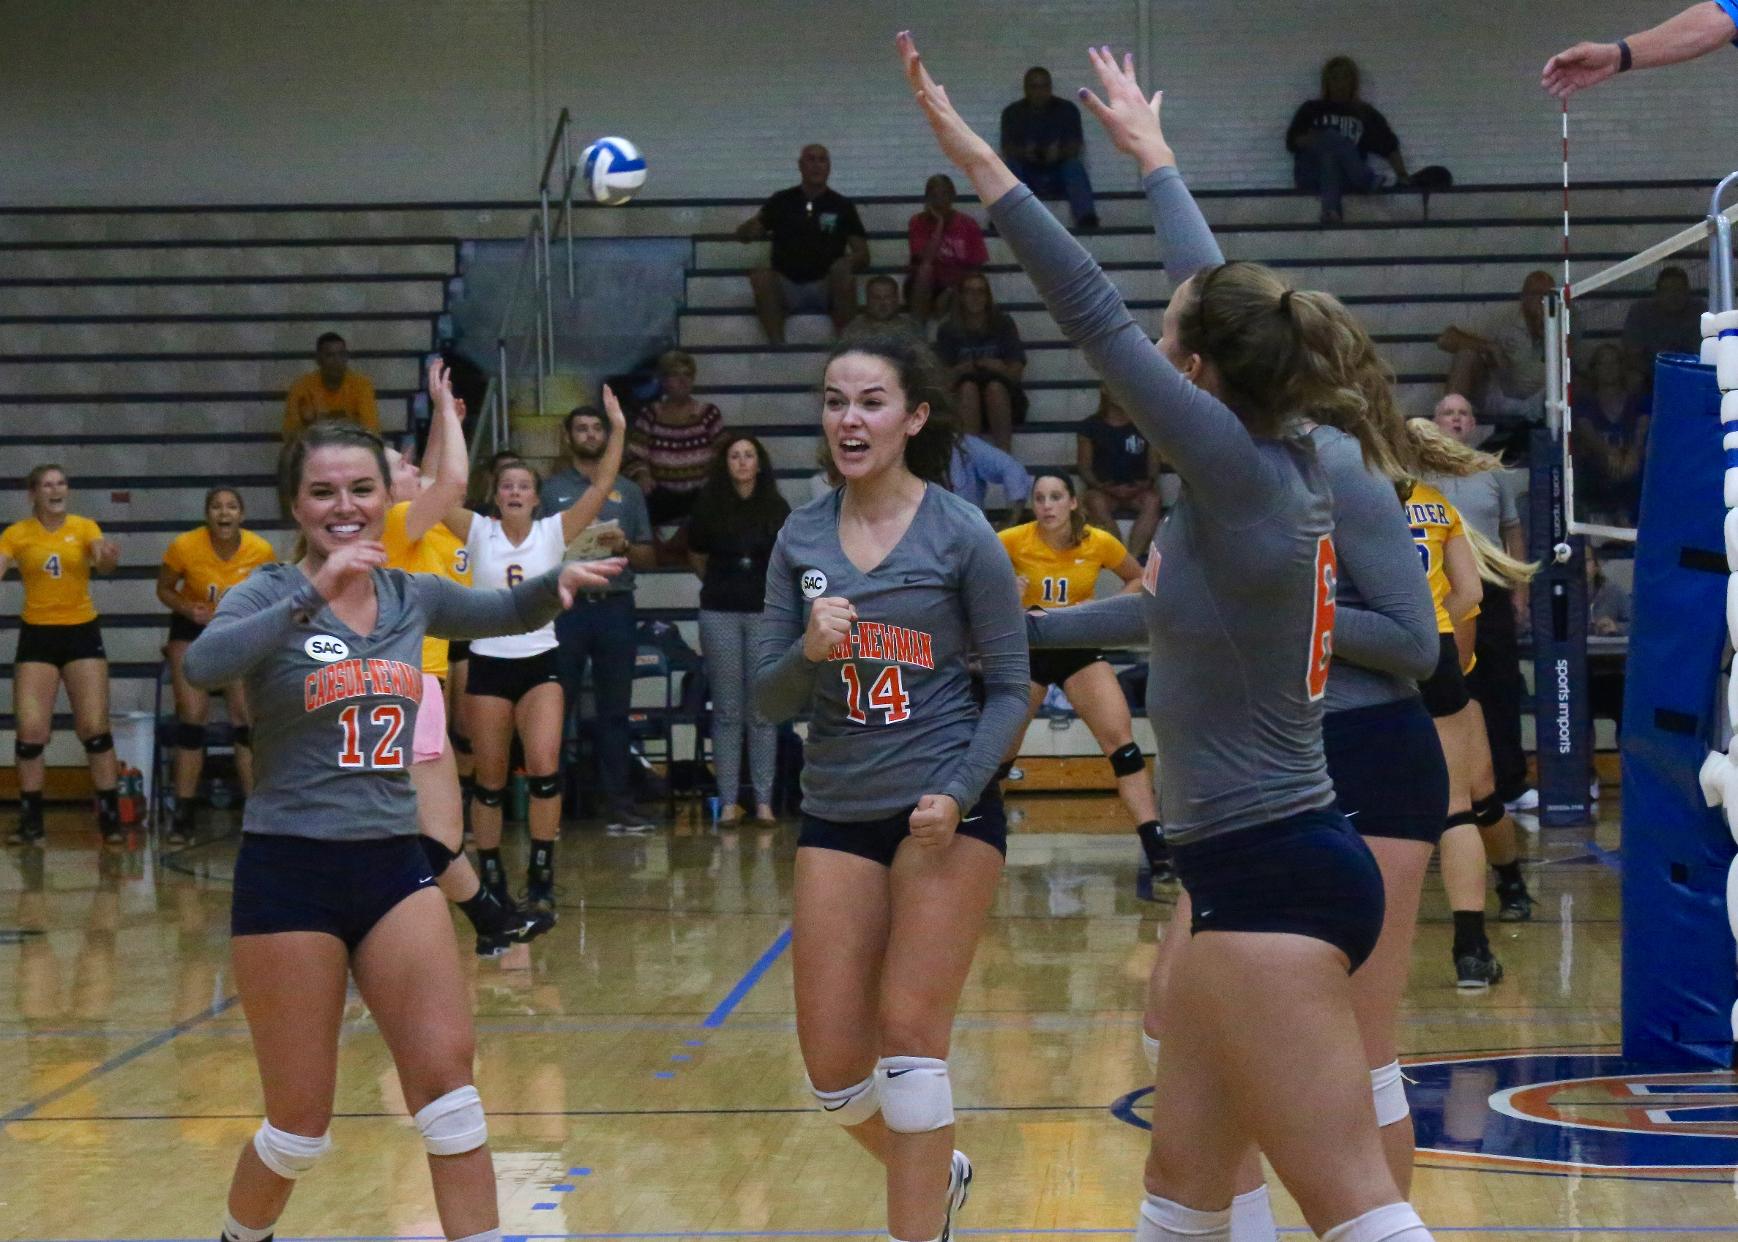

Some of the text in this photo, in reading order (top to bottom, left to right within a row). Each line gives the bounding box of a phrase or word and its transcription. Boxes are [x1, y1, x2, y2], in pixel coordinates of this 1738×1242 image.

[43, 553, 62, 578] 4
[454, 547, 470, 574] 3
[506, 562, 525, 590] 6
[804, 576, 823, 590] SAC
[1042, 576, 1068, 604] 11
[312, 641, 343, 654] SAC
[841, 663, 911, 725] 14
[1555, 659, 1571, 754] sports imports
[338, 704, 405, 769] 12
